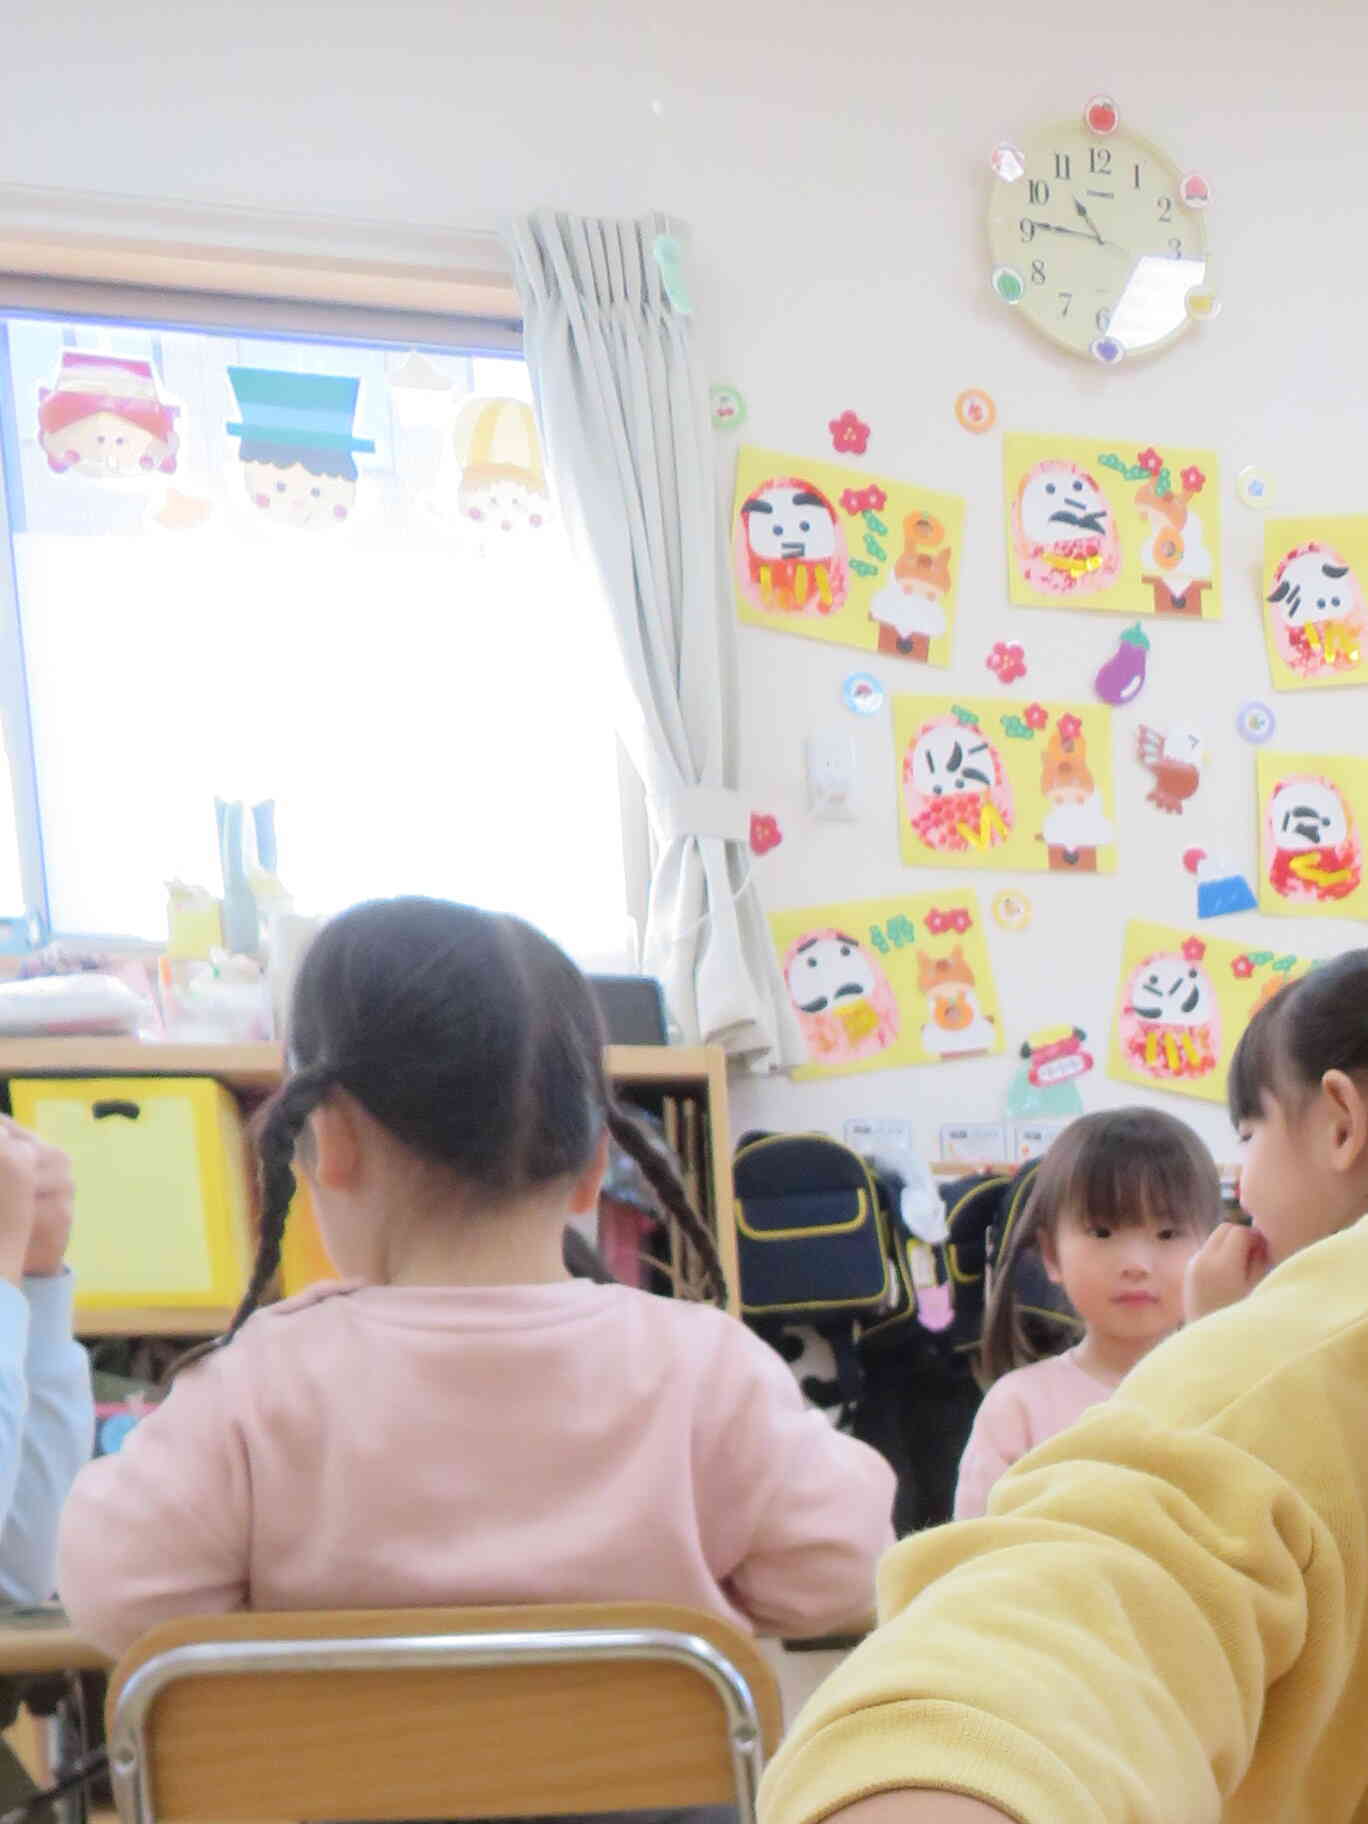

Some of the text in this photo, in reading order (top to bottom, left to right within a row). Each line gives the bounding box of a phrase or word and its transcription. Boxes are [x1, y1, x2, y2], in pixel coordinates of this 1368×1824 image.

[1054, 153, 1071, 180] 11
[1088, 148, 1112, 175] 12
[1132, 164, 1141, 190] 1
[1027, 179, 1050, 205] 10
[1156, 197, 1172, 223] 2
[1019, 217, 1037, 243] 9
[1031, 258, 1047, 285] 8
[1057, 292, 1073, 319] 7
